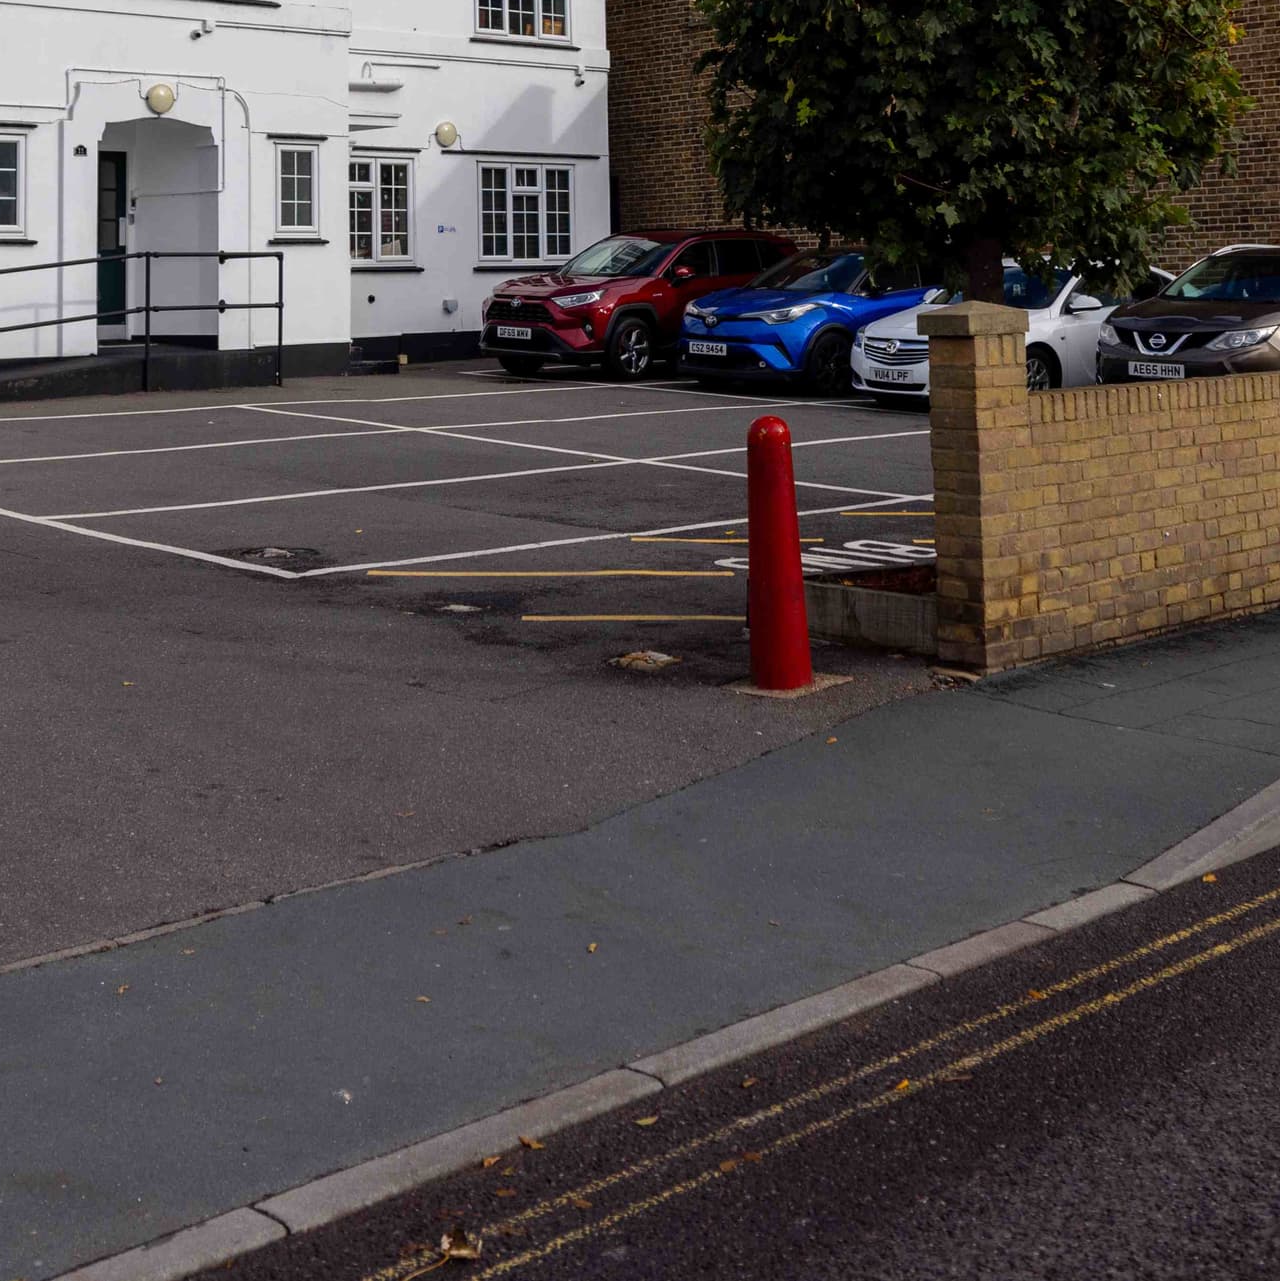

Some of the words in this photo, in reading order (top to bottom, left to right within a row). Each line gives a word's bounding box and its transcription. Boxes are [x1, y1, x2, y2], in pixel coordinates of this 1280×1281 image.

[705, 344, 724, 354] 9454
[1133, 364, 1158, 375] AE65
[1160, 365, 1181, 376] HHN
[892, 371, 909, 382] LPF
